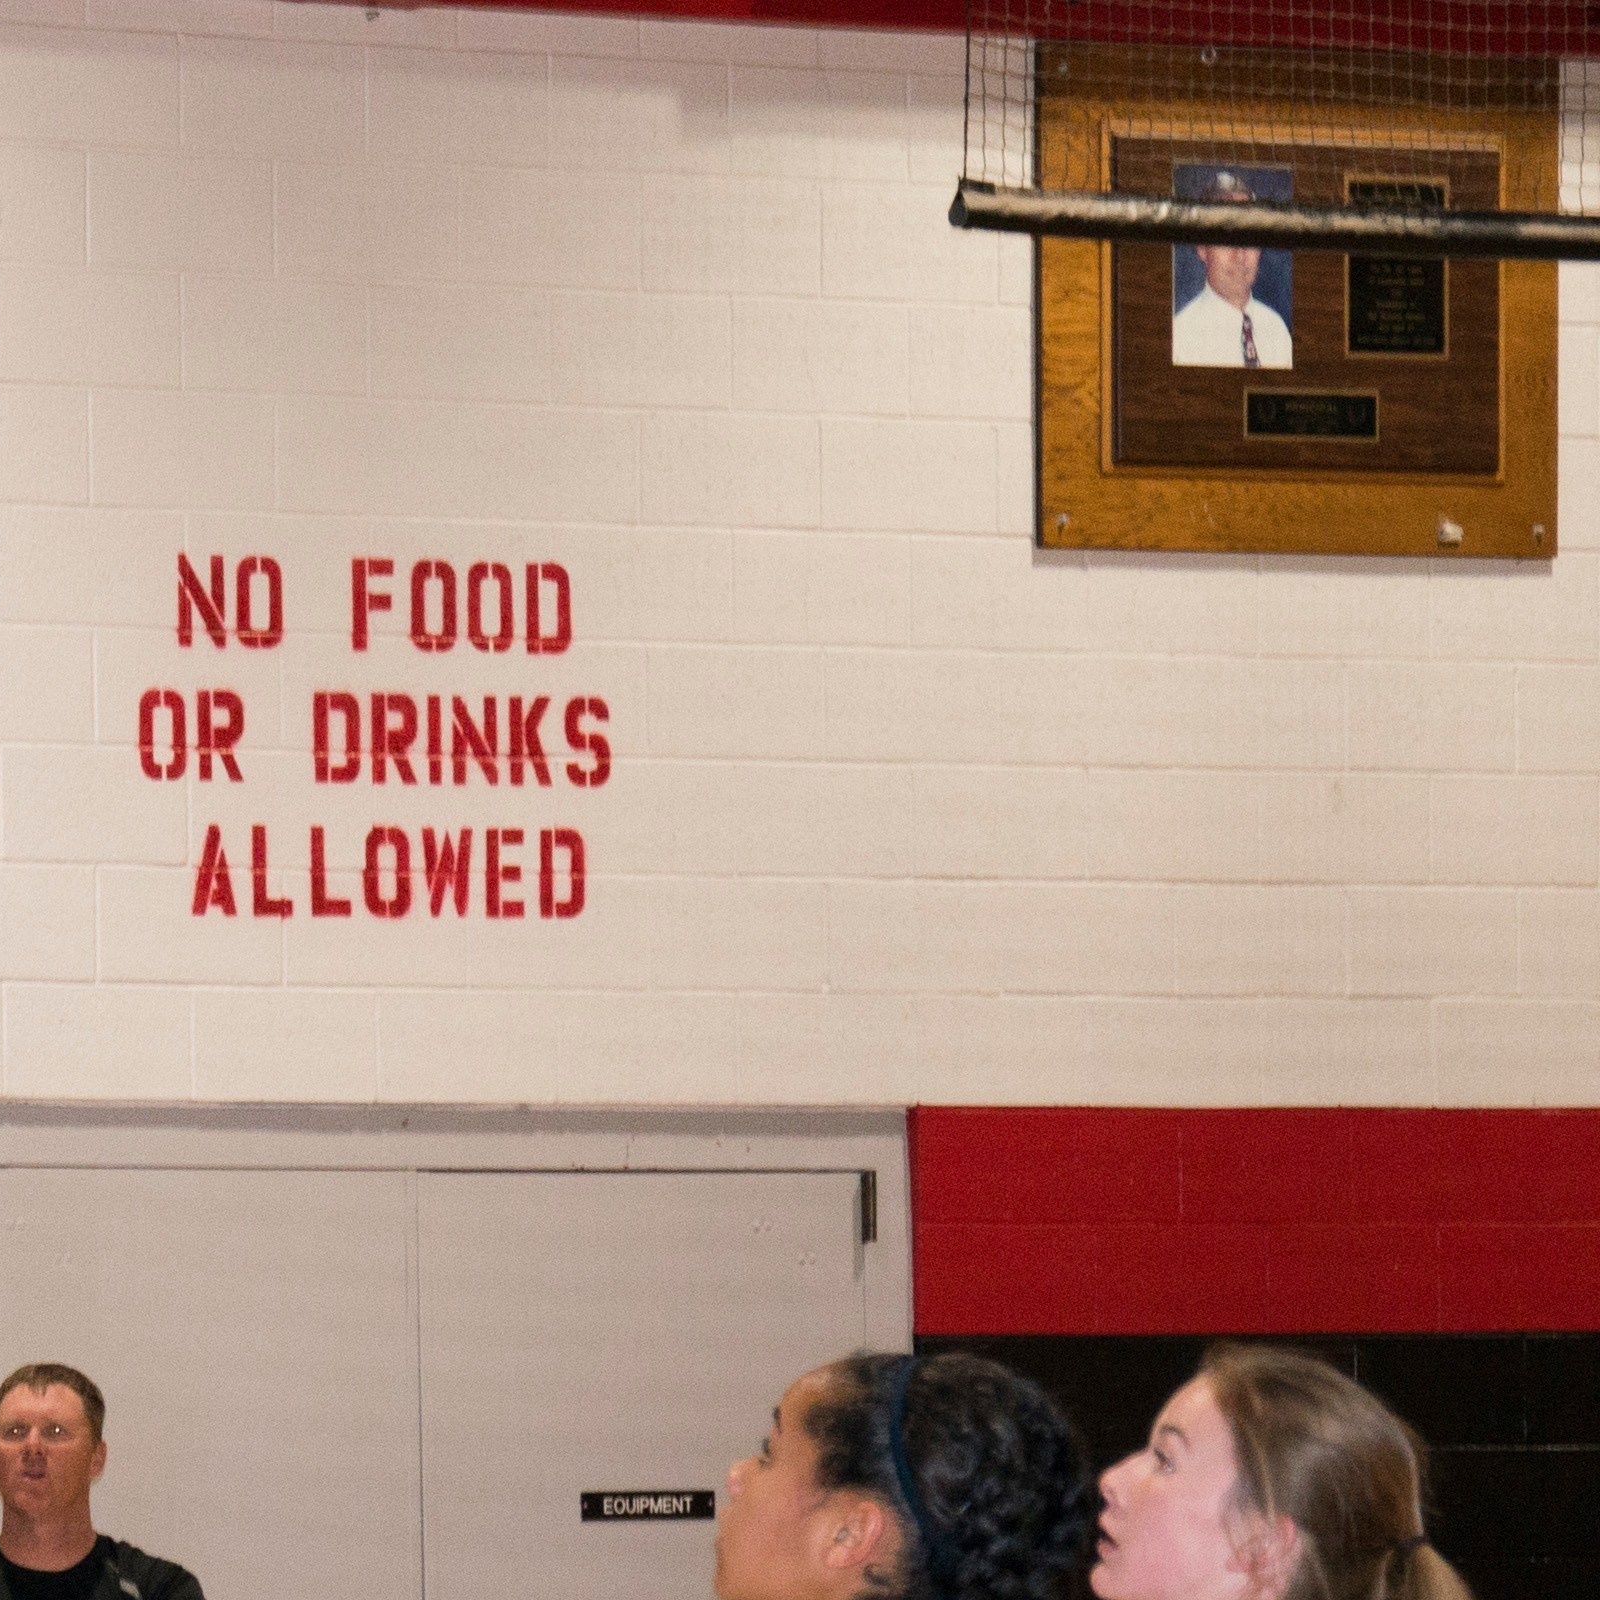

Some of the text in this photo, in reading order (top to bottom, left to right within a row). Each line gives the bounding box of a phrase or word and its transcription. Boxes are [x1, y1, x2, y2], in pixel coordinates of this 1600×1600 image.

[176, 551, 573, 655] NO FOOD
[138, 687, 612, 788] OR DRINKS
[191, 823, 587, 919] ALLOWED
[603, 1496, 692, 1515] EQUIPMENT
